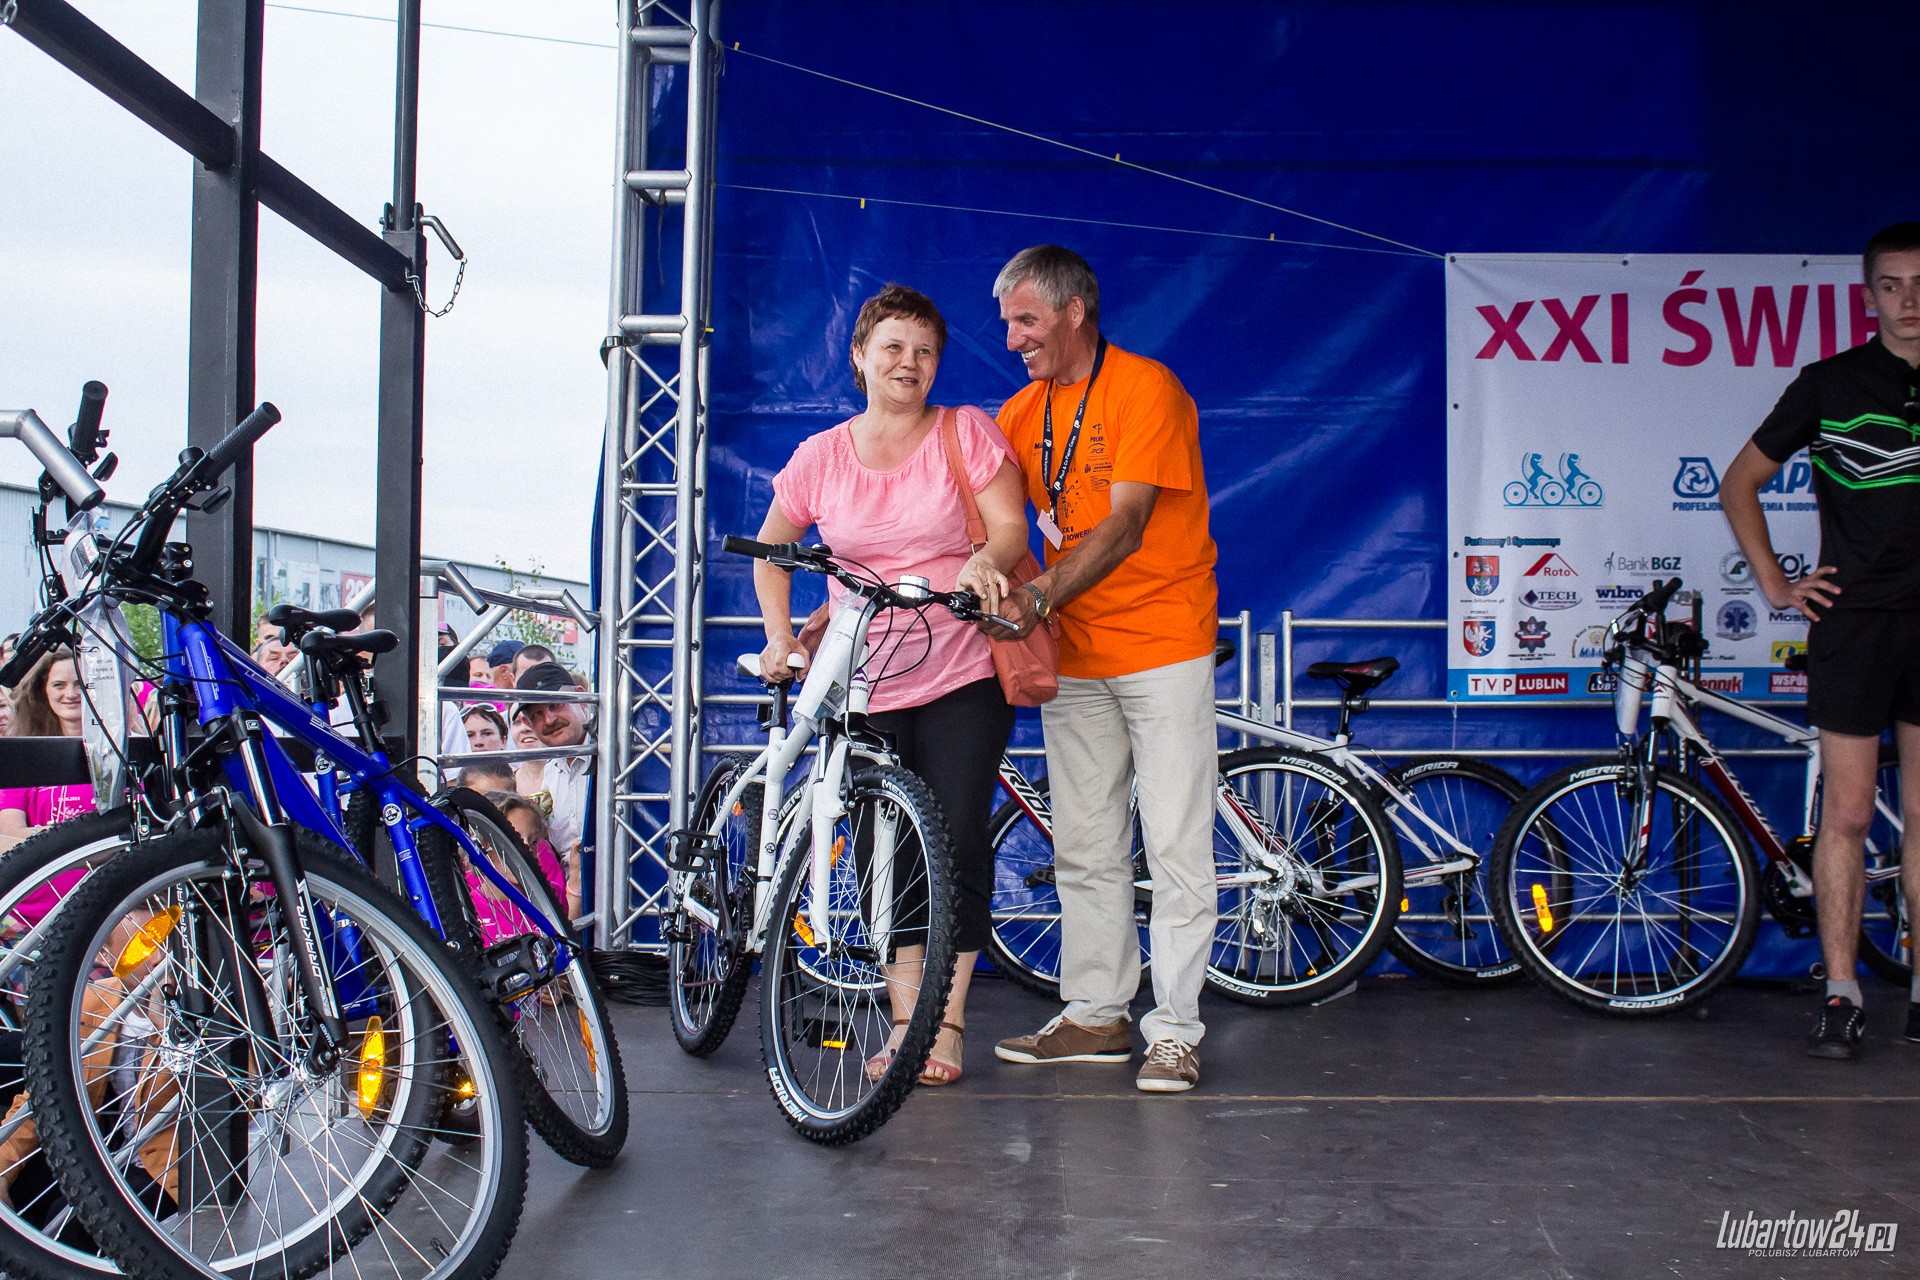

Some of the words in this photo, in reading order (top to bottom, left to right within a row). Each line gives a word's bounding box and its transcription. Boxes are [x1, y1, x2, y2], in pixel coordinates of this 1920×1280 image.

[1475, 292, 1629, 364] XXI
[1618, 556, 1649, 570] Bank
[1543, 567, 1571, 577] Roto
[1537, 591, 1577, 600] TECH
[1596, 585, 1645, 599] wibro
[1471, 678, 1513, 692] TVP
[1518, 677, 1566, 691] LUBLIN
[1278, 755, 1349, 786] MERIDA
[1402, 761, 1460, 781] MERIDA
[295, 896, 324, 984] DRAKAR
[1608, 992, 1685, 1009] MERIDA
[768, 1067, 809, 1123] MERIDA
